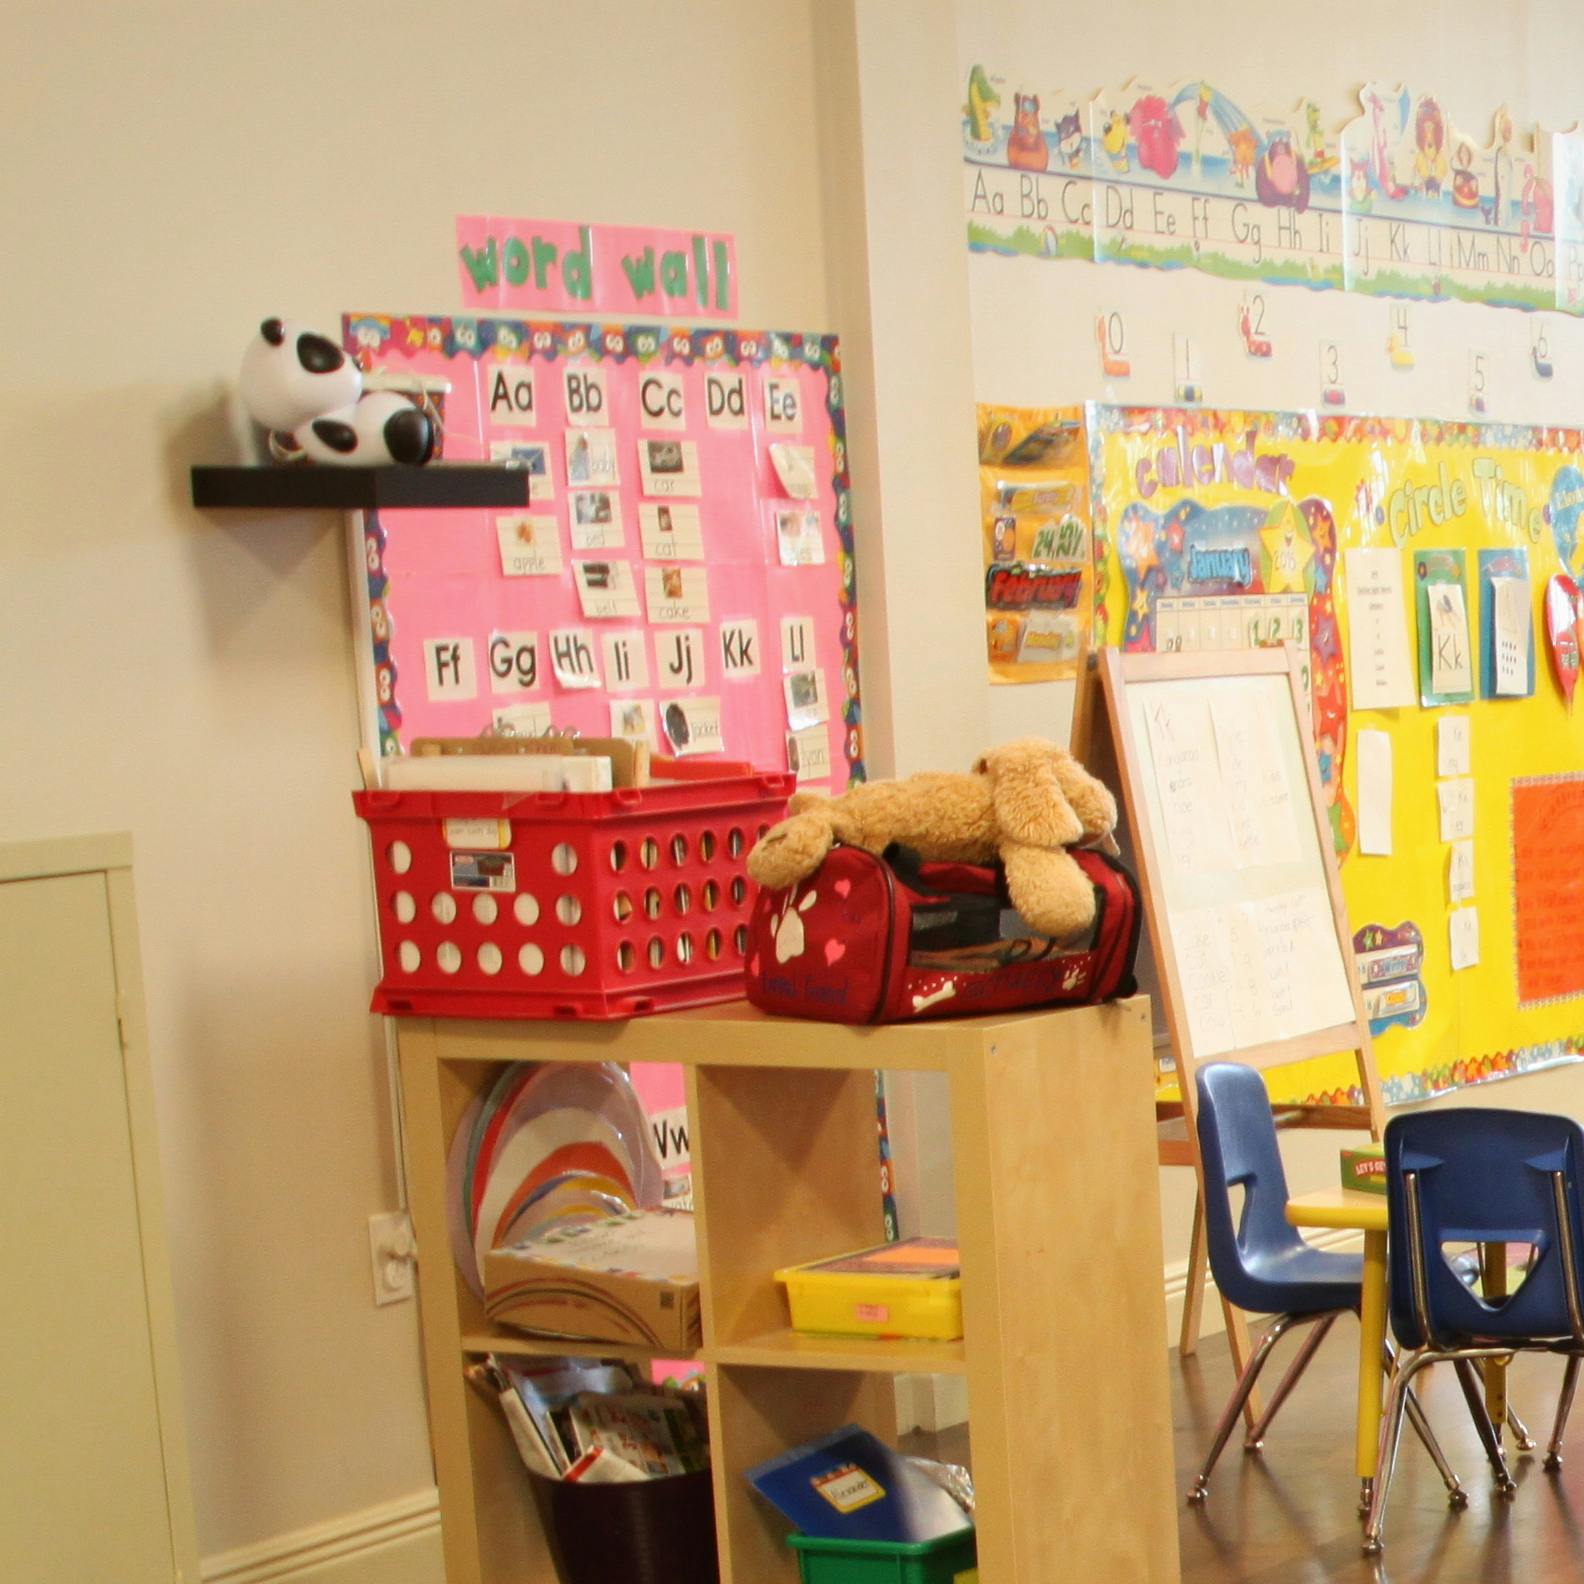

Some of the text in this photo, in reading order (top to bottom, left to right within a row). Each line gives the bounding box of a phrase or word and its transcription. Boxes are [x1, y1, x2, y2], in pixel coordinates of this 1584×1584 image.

[971, 170, 1004, 214] Aa
[1021, 175, 1048, 219] Bb
[1062, 181, 1091, 224] Cc
[1106, 186, 1133, 229] Dd
[1154, 193, 1175, 234] Ee
[1192, 197, 1209, 239] Ff
[1232, 203, 1261, 263] Gg
[1278, 208, 1301, 248] Hh
[1319, 213, 1330, 253] Ii
[1353, 218, 1369, 275] Jj
[1390, 223, 1409, 262] Kk
[1457, 233, 1489, 271] Mm
[1497, 237, 1520, 274] Nn
[1530, 241, 1553, 276] Oo
[460, 225, 730, 310] word wall
[1109, 312, 1124, 354] 0
[1253, 295, 1265, 336] 2
[1397, 307, 1409, 347] 4
[1537, 322, 1548, 359] 6
[1327, 345, 1339, 385] 3
[1475, 355, 1486, 393] 5
[491, 370, 797, 421] Aa Bb Cc Dd Ee
[1389, 457, 1543, 549] Circle Time
[512, 552, 546, 574] apple
[654, 541, 677, 556] cat
[1188, 545, 1252, 588] January
[435, 626, 805, 687] Ff Gg Hh Ii Jj Kk Ll
[1437, 634, 1464, 673] Kk
